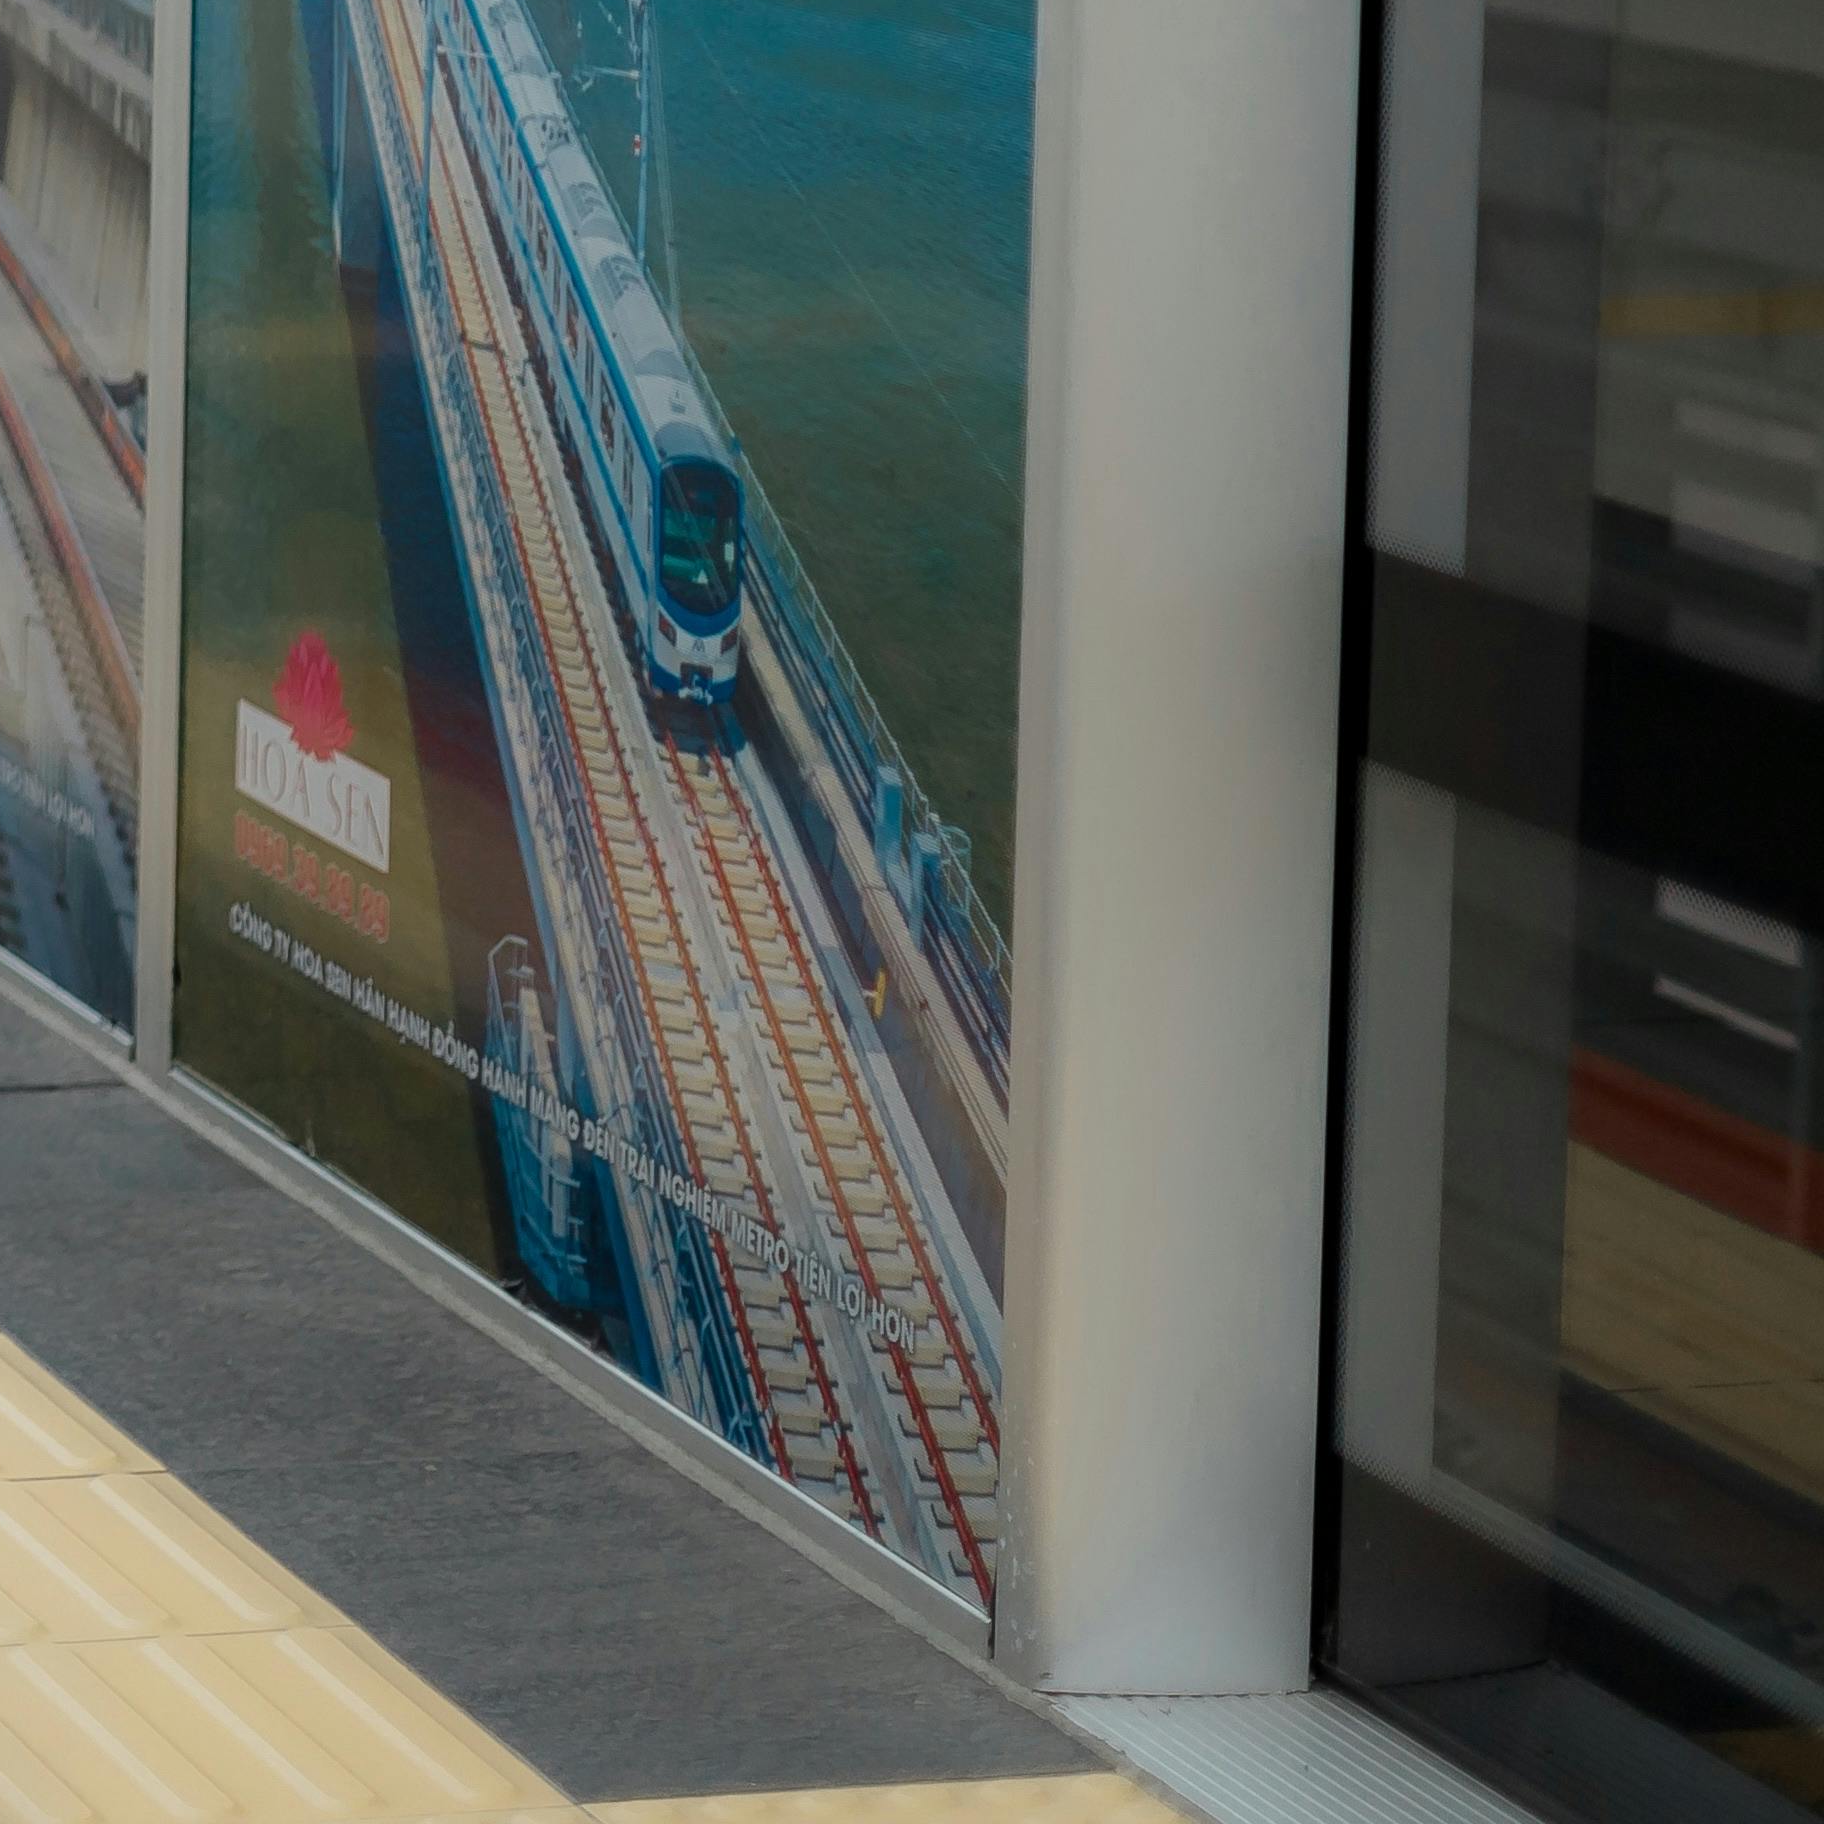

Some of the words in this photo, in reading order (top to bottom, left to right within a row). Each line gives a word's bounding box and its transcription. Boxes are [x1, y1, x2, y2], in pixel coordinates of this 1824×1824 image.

[239, 723, 312, 819] HOA
[273, 928, 291, 963] TY
[290, 941, 324, 985] HOA
[530, 1085, 580, 1141] MANG
[731, 1214, 790, 1273] METRO
[870, 1302, 915, 1354] HƠN
